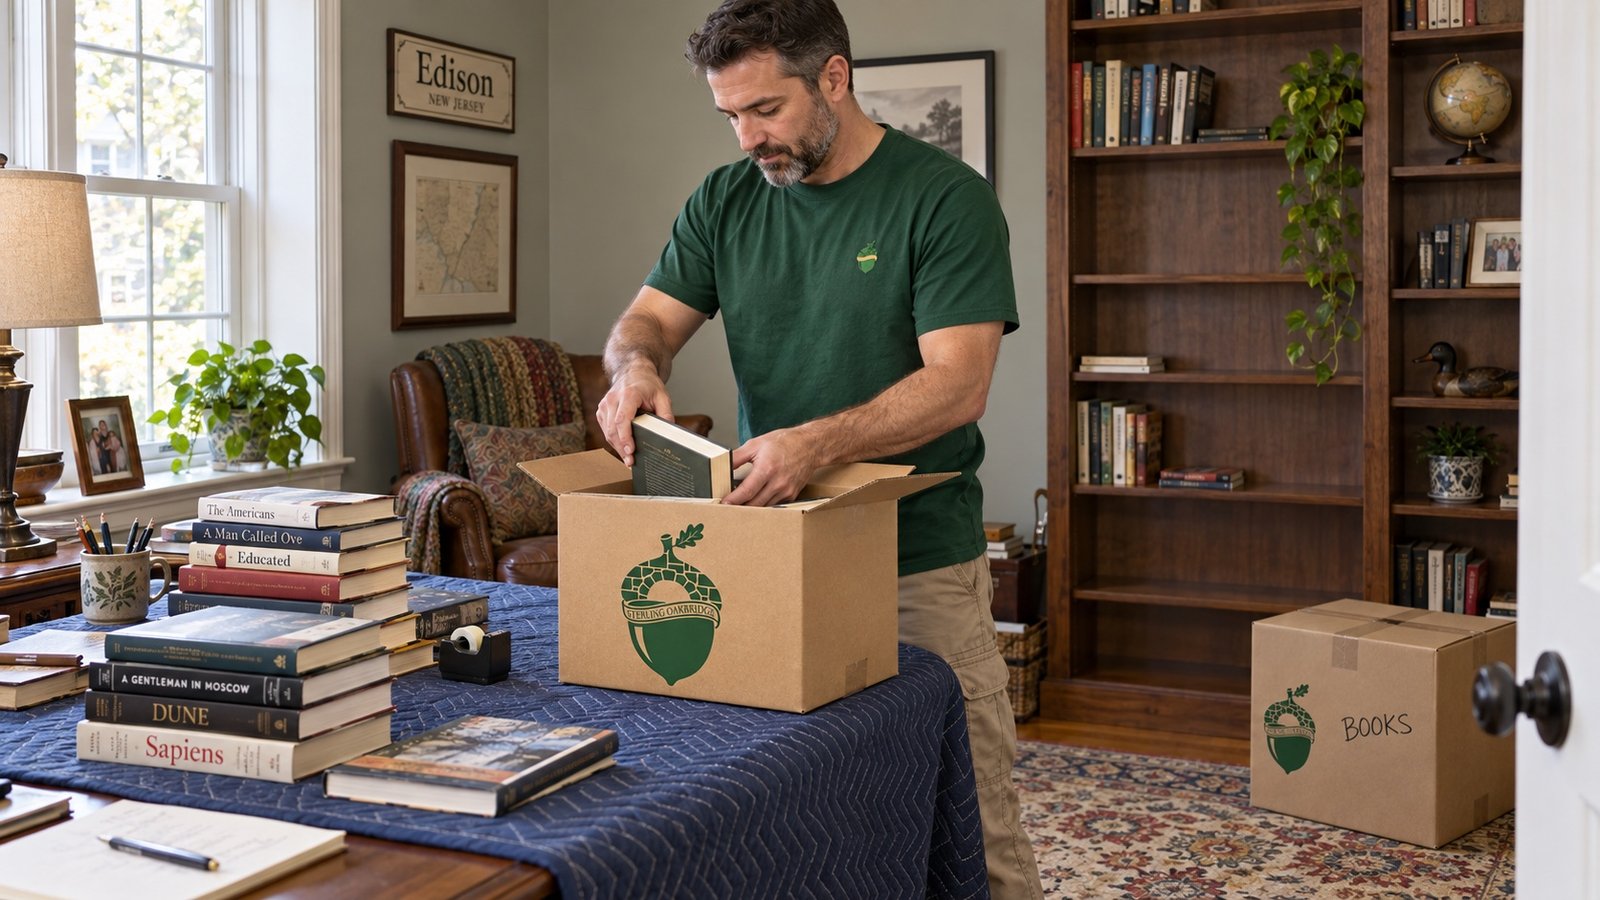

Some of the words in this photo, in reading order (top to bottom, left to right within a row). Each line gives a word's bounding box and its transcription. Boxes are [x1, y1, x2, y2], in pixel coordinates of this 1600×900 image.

[416, 50, 494, 98] Edison
[429, 93, 450, 107] NEW
[453, 97, 485, 113] JERSEY
[208, 504, 225, 516] The
[227, 505, 275, 519] Americans
[203, 528, 212, 539] A
[215, 528, 238, 541] Man
[242, 530, 277, 544] Called
[281, 532, 303, 545] Ove
[237, 551, 291, 567] Educated
[627, 609, 665, 619] STERLING
[666, 605, 715, 616] OAKBRIDGE
[121, 675, 128, 683] A
[131, 675, 188, 689] GENTLEMAN
[191, 680, 201, 690] IN
[205, 681, 250, 694] MOSCOW
[152, 703, 209, 726] DUNE
[1341, 713, 1412, 742] BOOKS
[146, 735, 224, 765] Sapiens
